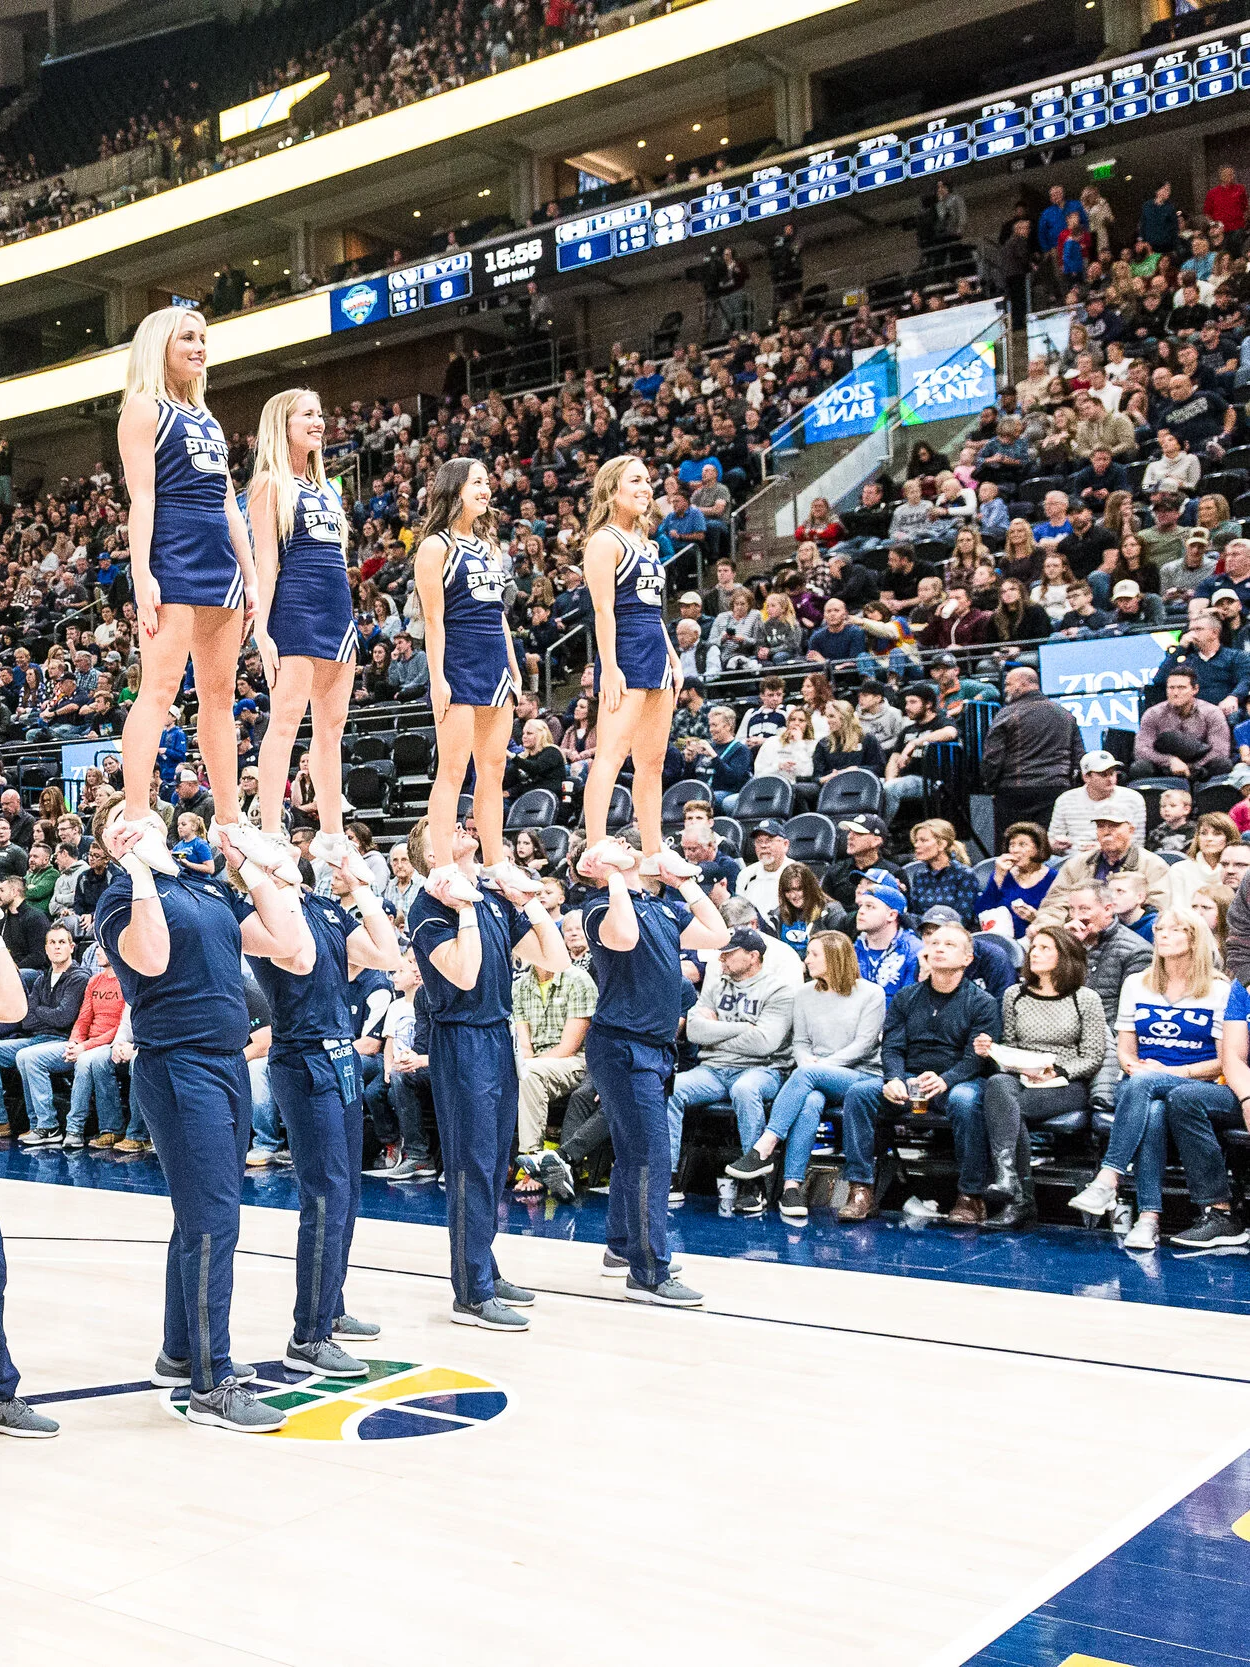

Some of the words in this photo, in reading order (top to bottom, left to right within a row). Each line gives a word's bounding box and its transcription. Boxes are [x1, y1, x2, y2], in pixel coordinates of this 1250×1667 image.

[1197, 40, 1229, 57] STL
[1153, 51, 1187, 69] AST
[1209, 58, 1220, 72] 1
[1166, 70, 1176, 84] 1
[1209, 80, 1222, 94] 0
[1165, 91, 1179, 106] 0
[927, 118, 948, 133] FT
[706, 182, 723, 196] FG
[484, 238, 543, 273] 15:56
[577, 241, 592, 260] 4
[912, 359, 984, 389] ZIONS
[914, 378, 989, 408] BANK
[1060, 697, 1140, 727] BAN
[91, 990, 119, 1000] RVCA
[717, 992, 759, 1016] BYU
[1135, 1007, 1209, 1027] BYU
